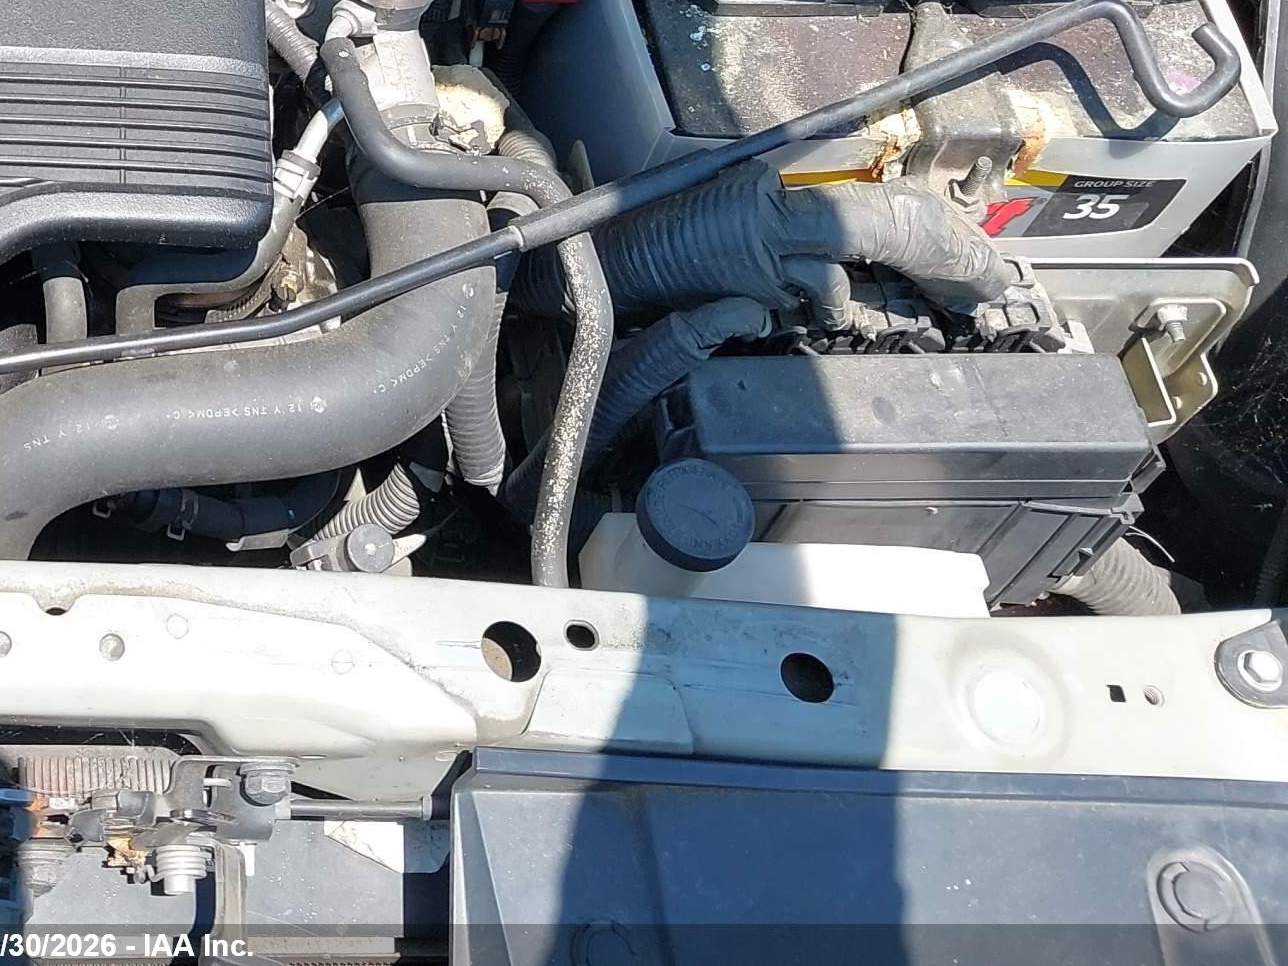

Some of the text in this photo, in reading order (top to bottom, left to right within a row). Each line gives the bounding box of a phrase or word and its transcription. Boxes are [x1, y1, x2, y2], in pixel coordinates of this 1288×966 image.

[1074, 180, 1155, 188] GROUP SIZE
[1062, 194, 1129, 219] 35
[288, 403, 302, 414] 12
